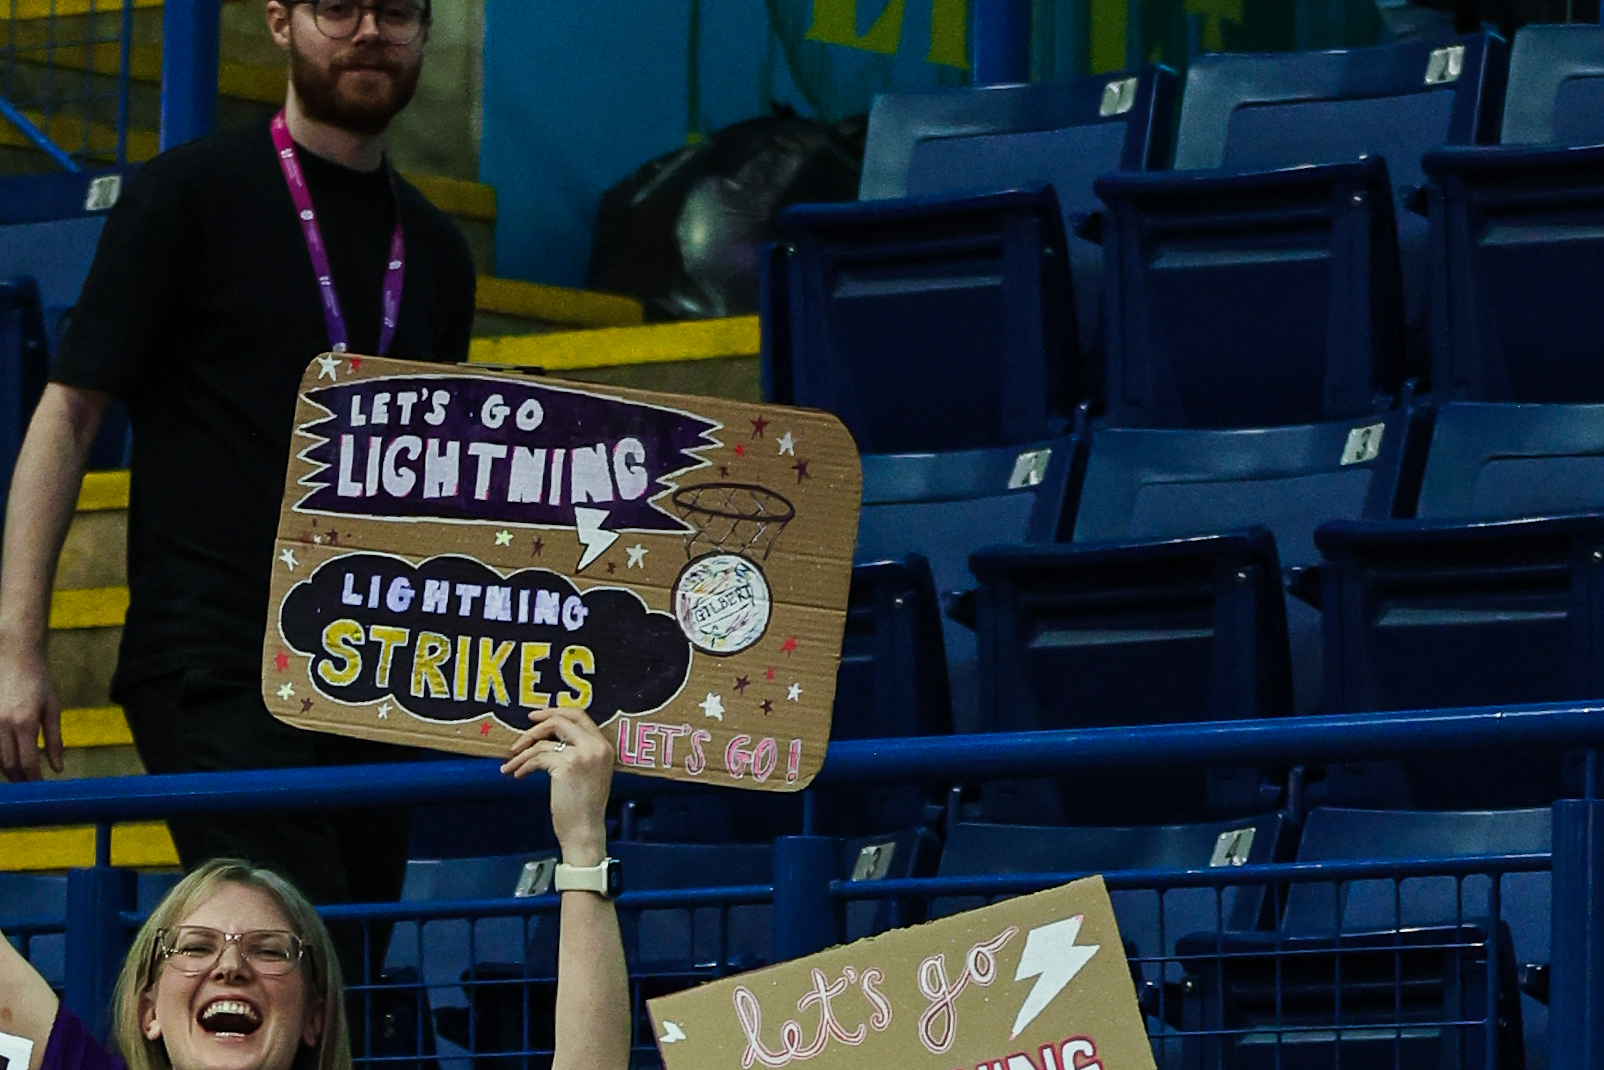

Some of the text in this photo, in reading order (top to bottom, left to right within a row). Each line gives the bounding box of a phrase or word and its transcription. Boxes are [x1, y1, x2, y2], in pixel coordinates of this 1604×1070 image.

[349, 388, 545, 431] LET'S GO
[337, 434, 650, 506] LIGHTNING
[341, 572, 590, 631] LIGHTNING
[694, 584, 755, 623] GILBERT
[317, 618, 596, 710] STRIKES
[617, 717, 712, 776] LET'S
[732, 926, 1019, 1069] let's go
